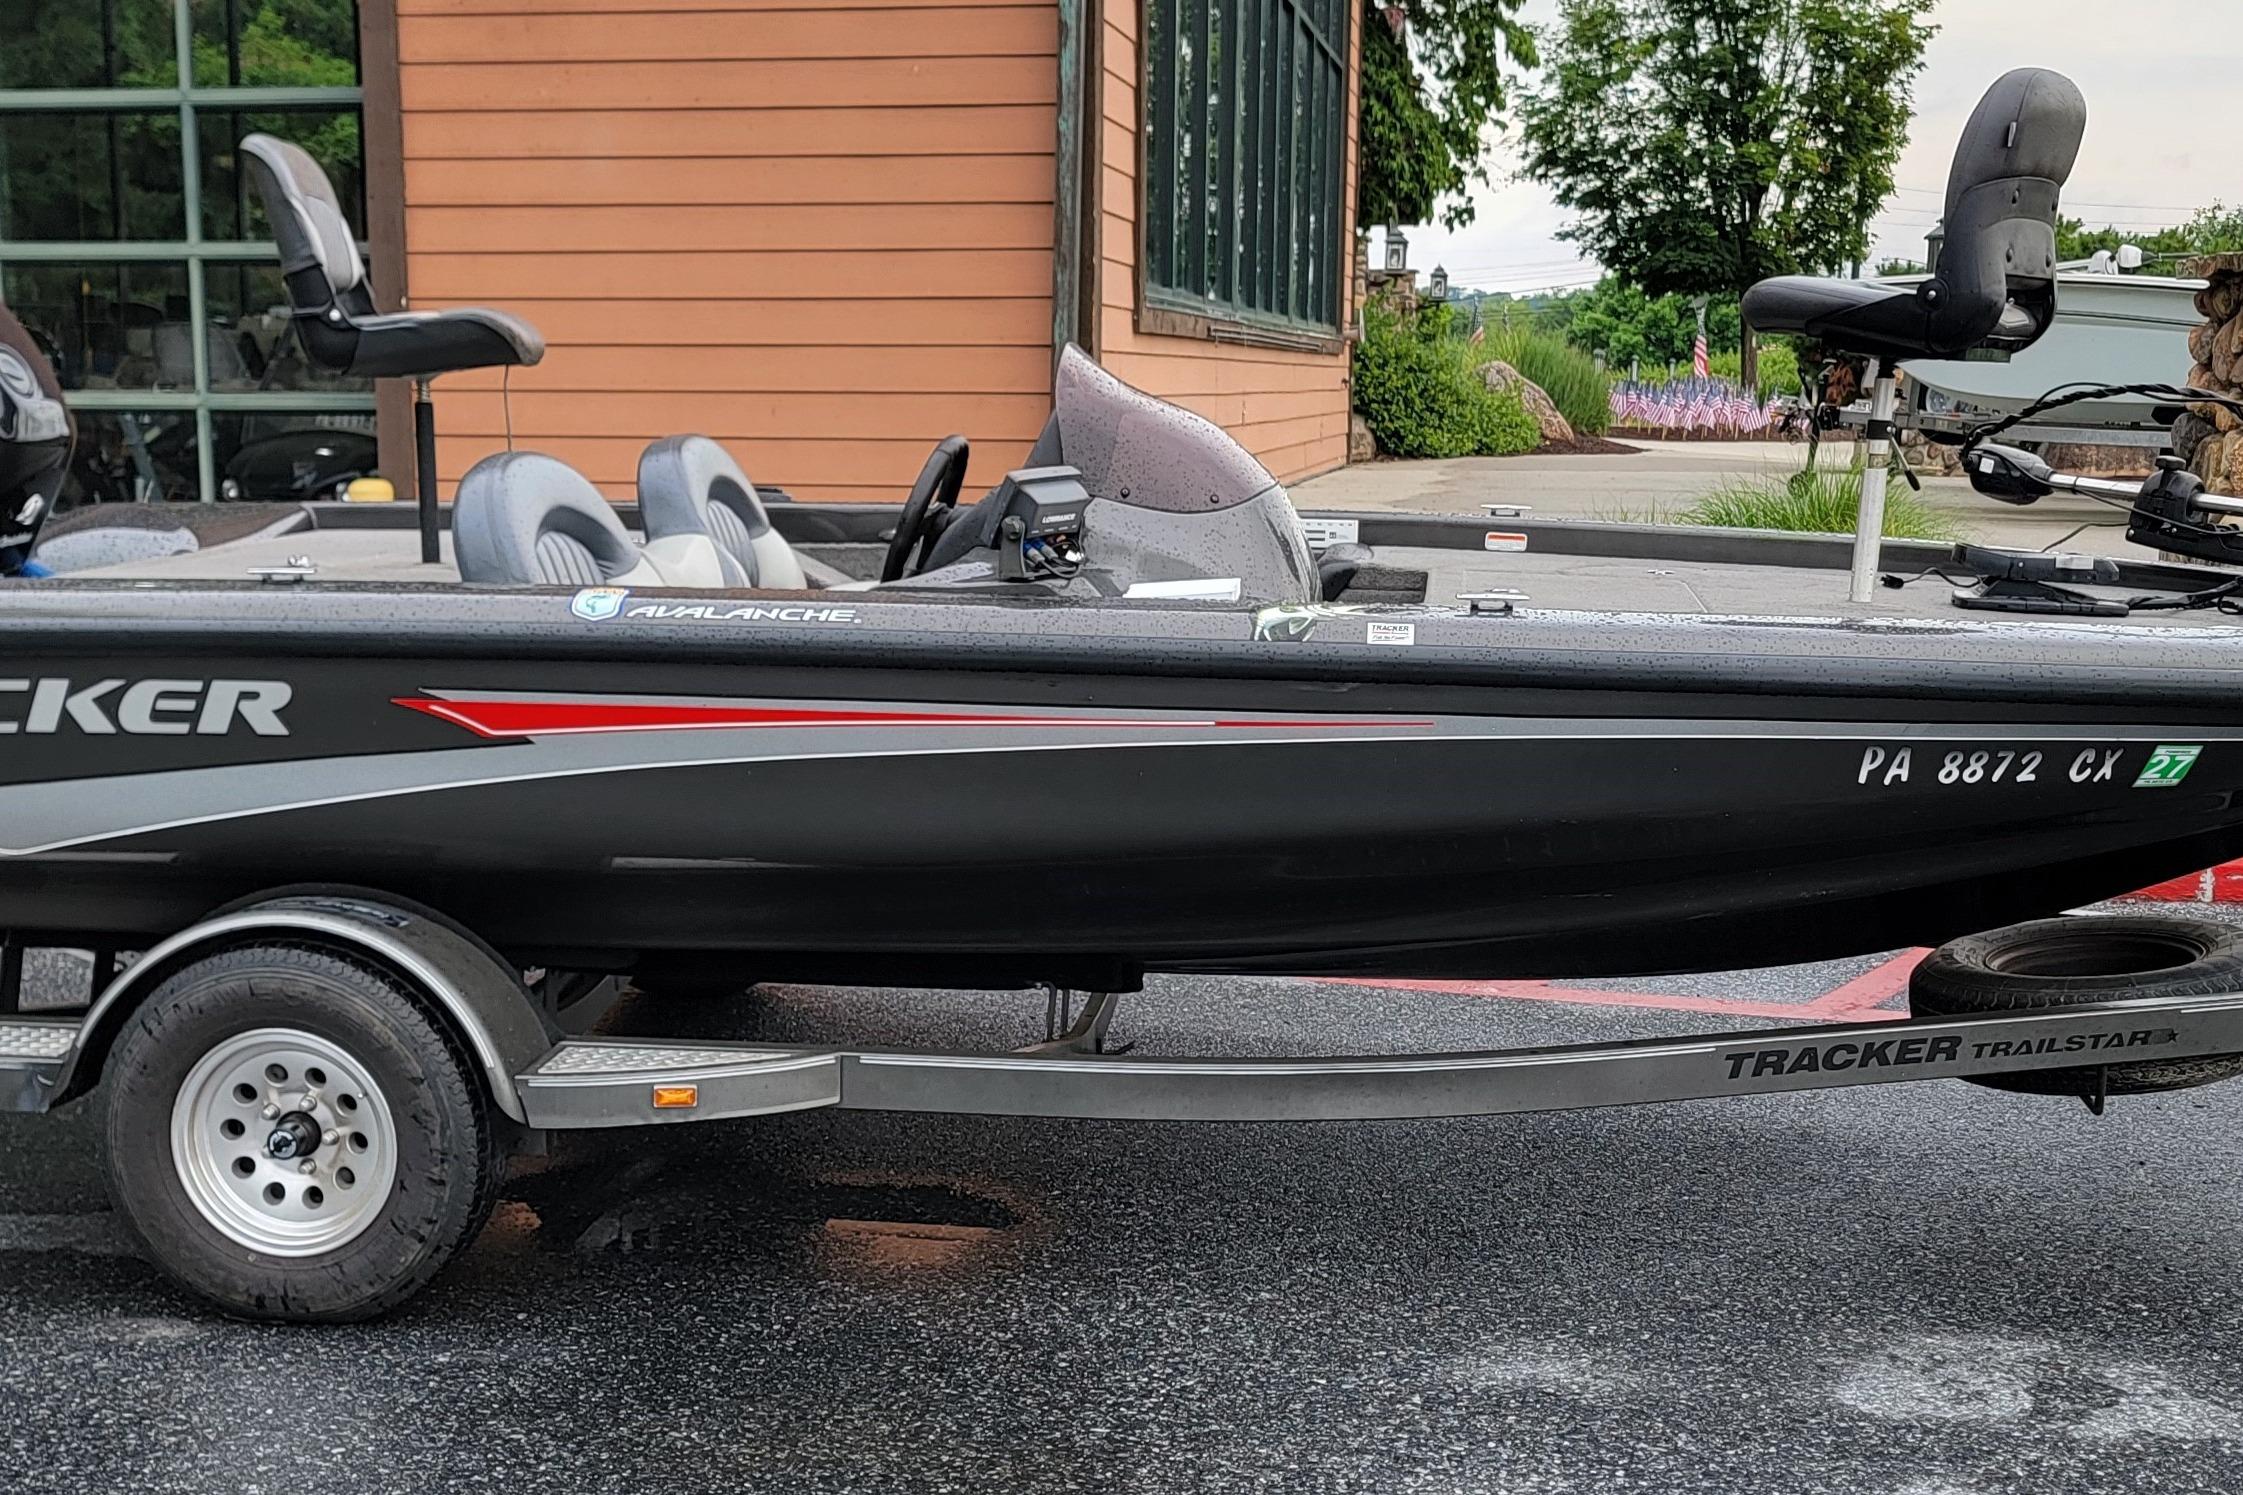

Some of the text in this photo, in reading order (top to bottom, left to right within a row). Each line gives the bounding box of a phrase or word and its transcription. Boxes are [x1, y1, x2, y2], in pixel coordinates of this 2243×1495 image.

[626, 605, 856, 623] AVALANCHE
[1857, 745, 2125, 786] PA 8872 CX
[2140, 755, 2196, 779] 27
[1724, 1029, 2153, 1080] TRACKER TRAILSTAR
